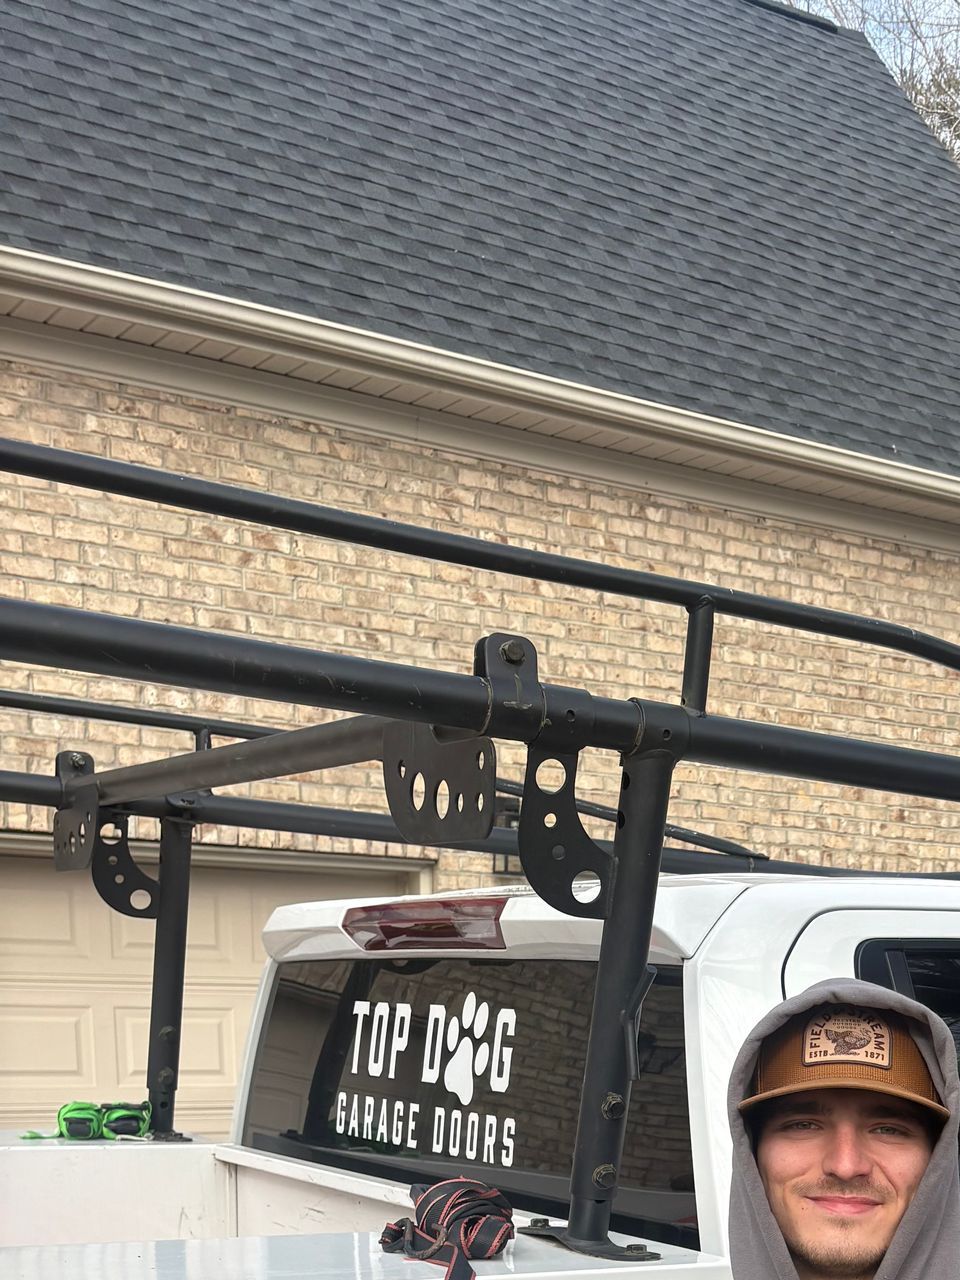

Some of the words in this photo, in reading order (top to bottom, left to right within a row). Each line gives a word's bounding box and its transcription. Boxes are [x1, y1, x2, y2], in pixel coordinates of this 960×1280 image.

[351, 1000, 412, 1079] TOP
[809, 1012, 831, 1049] FIELD
[809, 1050, 829, 1059] ESTB
[864, 1050, 885, 1061] 1871
[335, 1091, 420, 1149] GARAGE
[432, 1106, 516, 1168] DOORS
